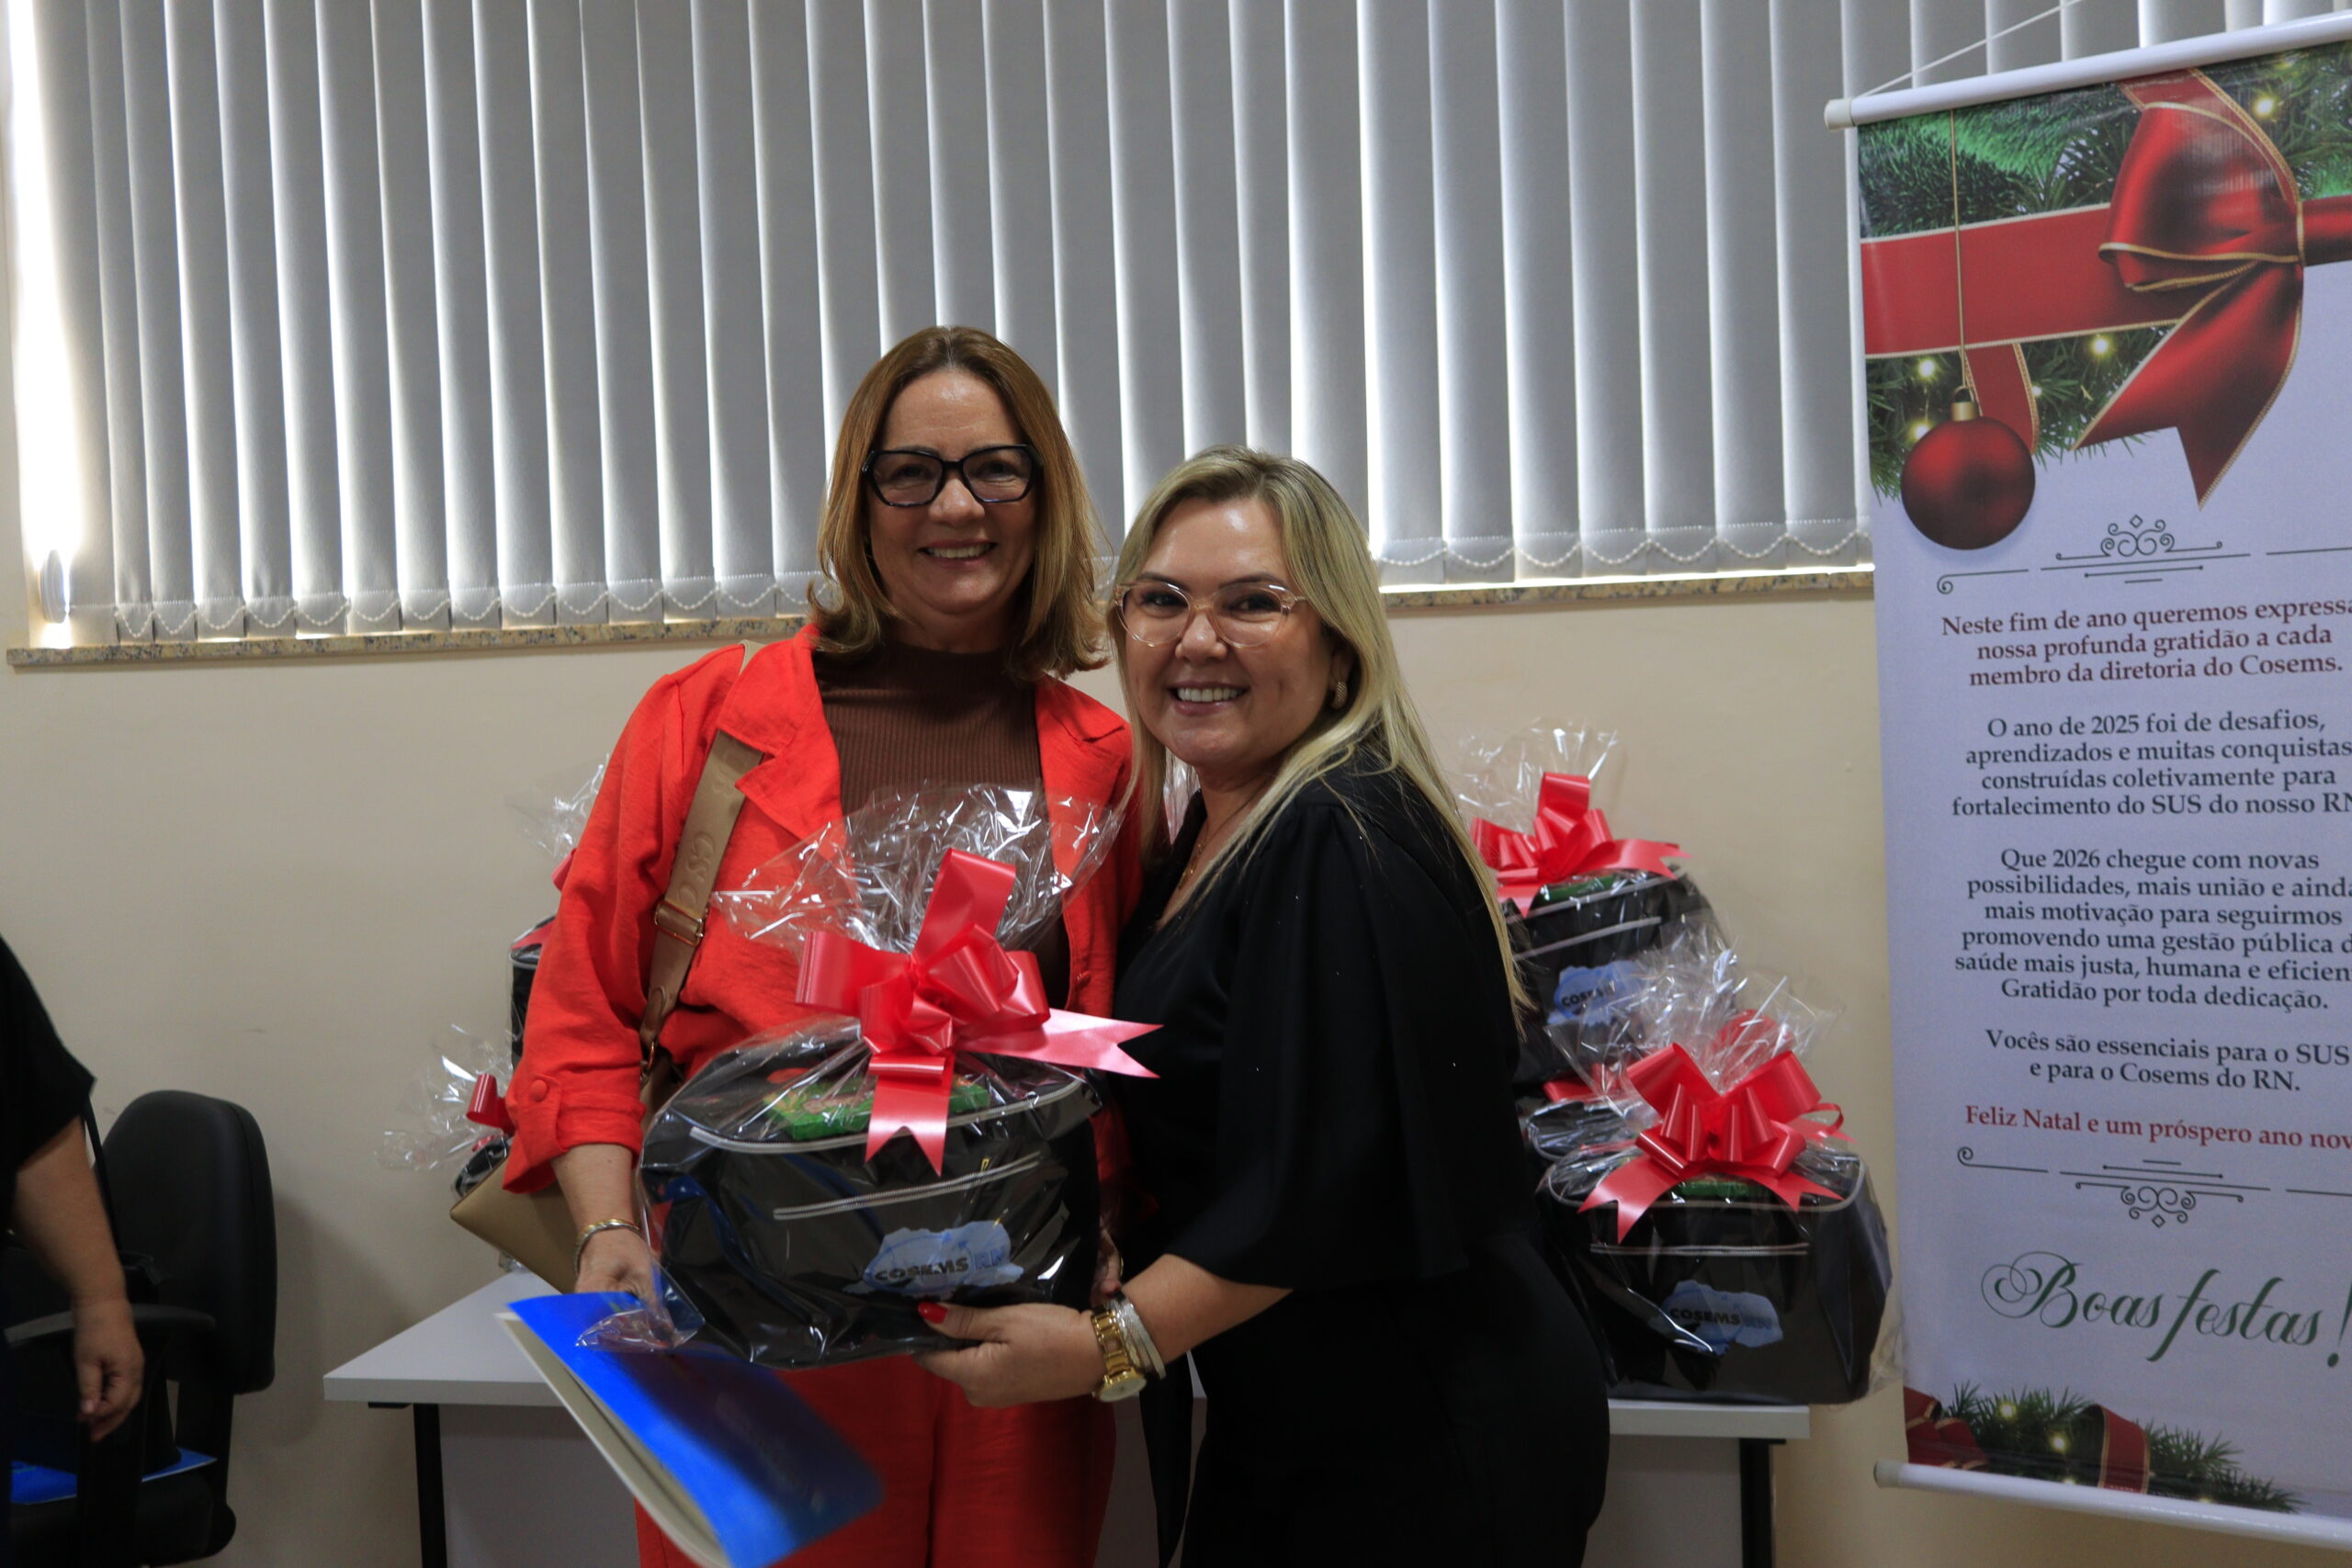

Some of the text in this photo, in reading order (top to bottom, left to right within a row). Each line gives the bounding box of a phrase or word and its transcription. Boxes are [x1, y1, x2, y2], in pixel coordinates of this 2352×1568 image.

[1941, 616, 2004, 636] Neste
[2009, 612, 2048, 632] fim
[2053, 609, 2080, 630] de
[2086, 612, 2127, 628] ano
[2132, 605, 2248, 631] queremos
[1977, 625, 2333, 663] nossa profunda gratidão a cada
[1969, 654, 2343, 686] membro da diretoria do Cosems.
[1987, 708, 2325, 738] O ano de 2025 foi de desafios,
[1965, 736, 2352, 770] aprendizados e muitas conquistas
[1981, 767, 2336, 792] construídas coletivamente para
[1952, 795, 2111, 816] fortalecimento
[2117, 795, 2145, 815] do
[2152, 794, 2202, 815] SUS
[2209, 793, 2239, 814] do
[2245, 798, 2315, 814] nosso
[2000, 849, 2320, 875] Que 2026 chegue com novas
[1967, 874, 2131, 899] possibilidades,
[2137, 876, 2191, 896] mais
[2197, 876, 2266, 897] união
[2271, 883, 2285, 897] e
[1984, 900, 2343, 931] mais motivação para seguirmos
[1962, 928, 2100, 951] promovendo
[2106, 934, 2155, 949] uma
[2162, 932, 2235, 955] gestão
[2242, 931, 2334, 958] pública
[1955, 952, 2351, 982] saúde mais justa, humana e eficien
[2001, 978, 2328, 1013] Gratidão por toda dedicação.
[1985, 1029, 2050, 1051] Vocês
[2055, 1035, 2091, 1053] são
[2097, 1037, 2210, 1059] essenciais
[2216, 1045, 2267, 1066] para
[2274, 1048, 2289, 1063] o
[2030, 1063, 2301, 1091] e para o Cosems do RN.
[1966, 1105, 2018, 1126] Feliz
[2023, 1109, 2081, 1132] Natal
[2086, 1118, 2099, 1133] e
[2105, 1120, 2143, 1135] um
[2148, 1119, 2252, 1146] próspero
[2258, 1130, 2303, 1146] ano
[1981, 1250, 2165, 1328] Boas
[1670, 1308, 1741, 1325] COSEMS
